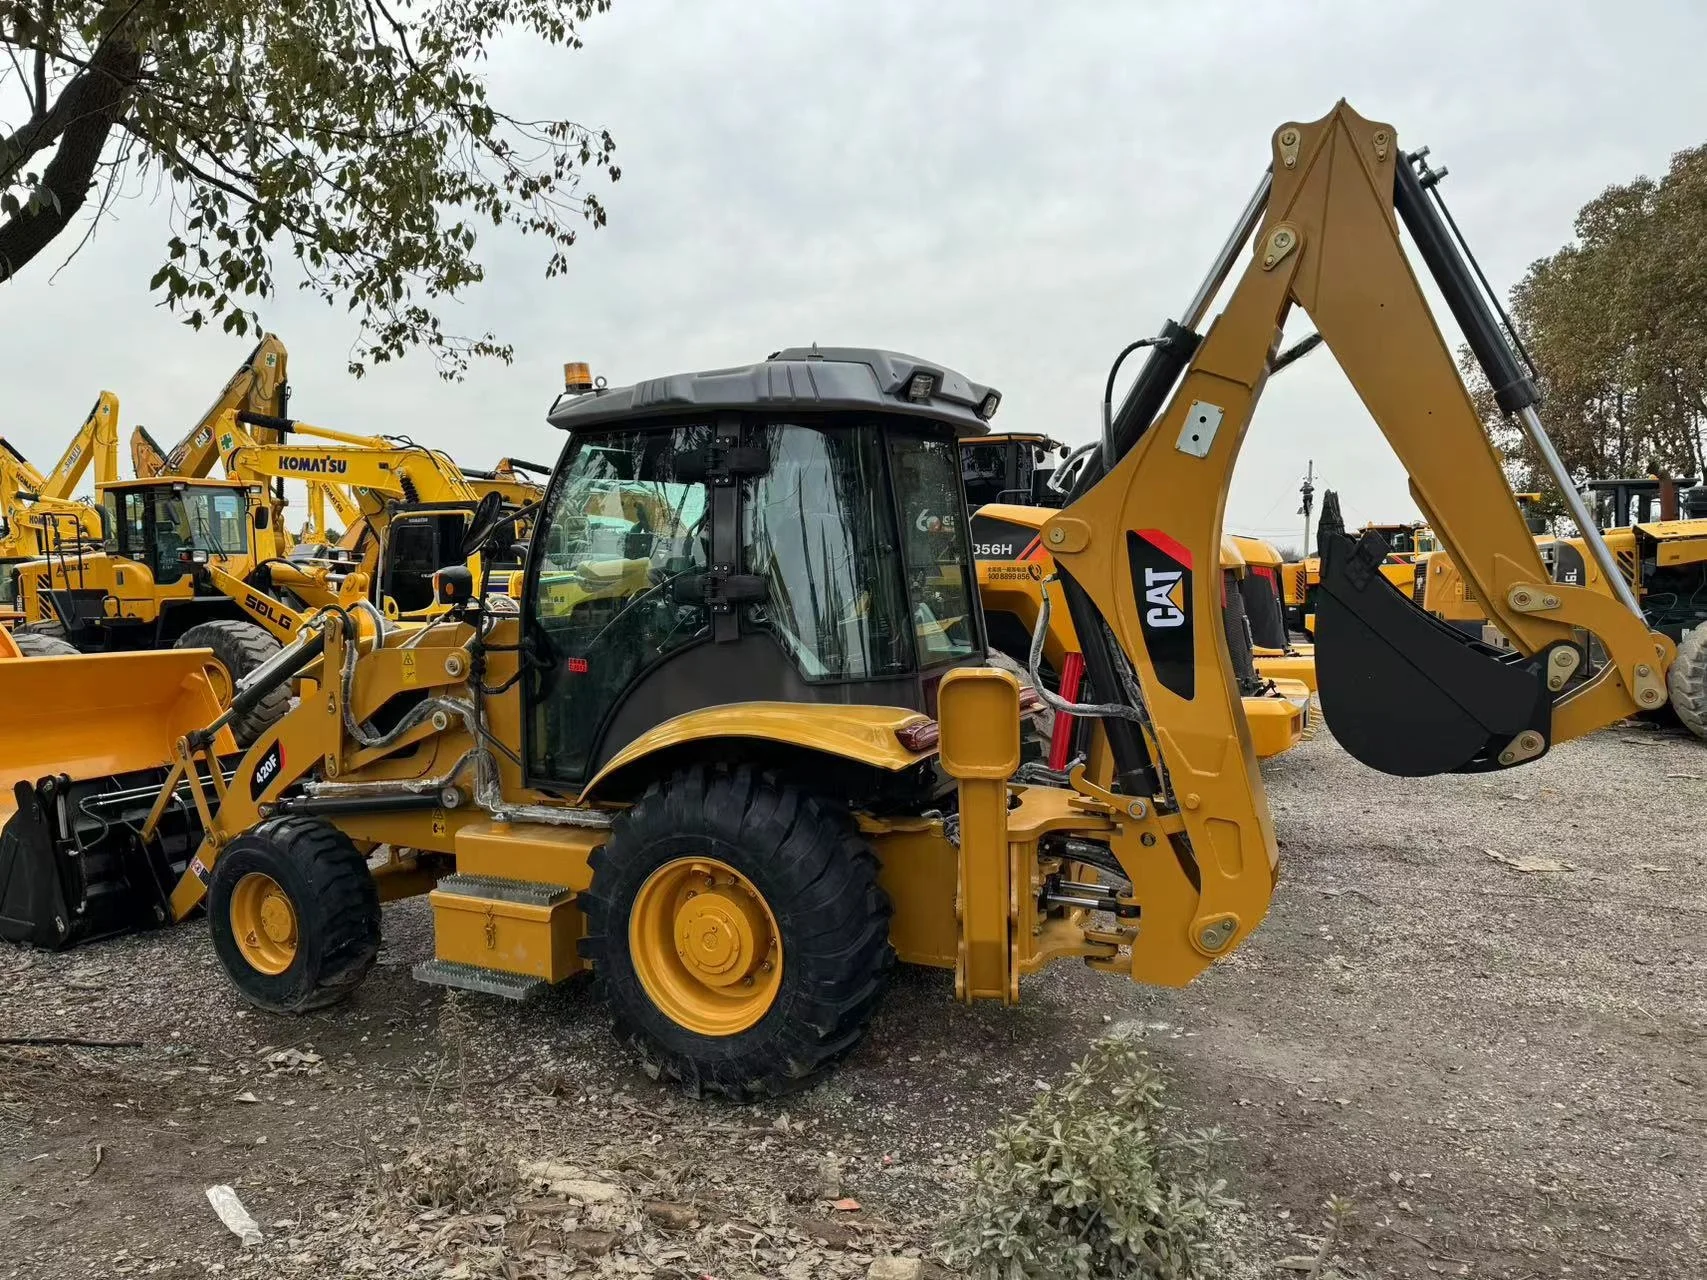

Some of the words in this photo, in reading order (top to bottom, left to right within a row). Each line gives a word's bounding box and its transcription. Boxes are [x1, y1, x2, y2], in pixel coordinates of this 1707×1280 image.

[195, 429, 209, 447] CAT
[278, 455, 347, 473] KOMATSU
[321, 483, 344, 513] KOMATSU
[245, 594, 292, 630] SDLG
[1145, 567, 1185, 628] CAT
[256, 753, 277, 783] 420F
